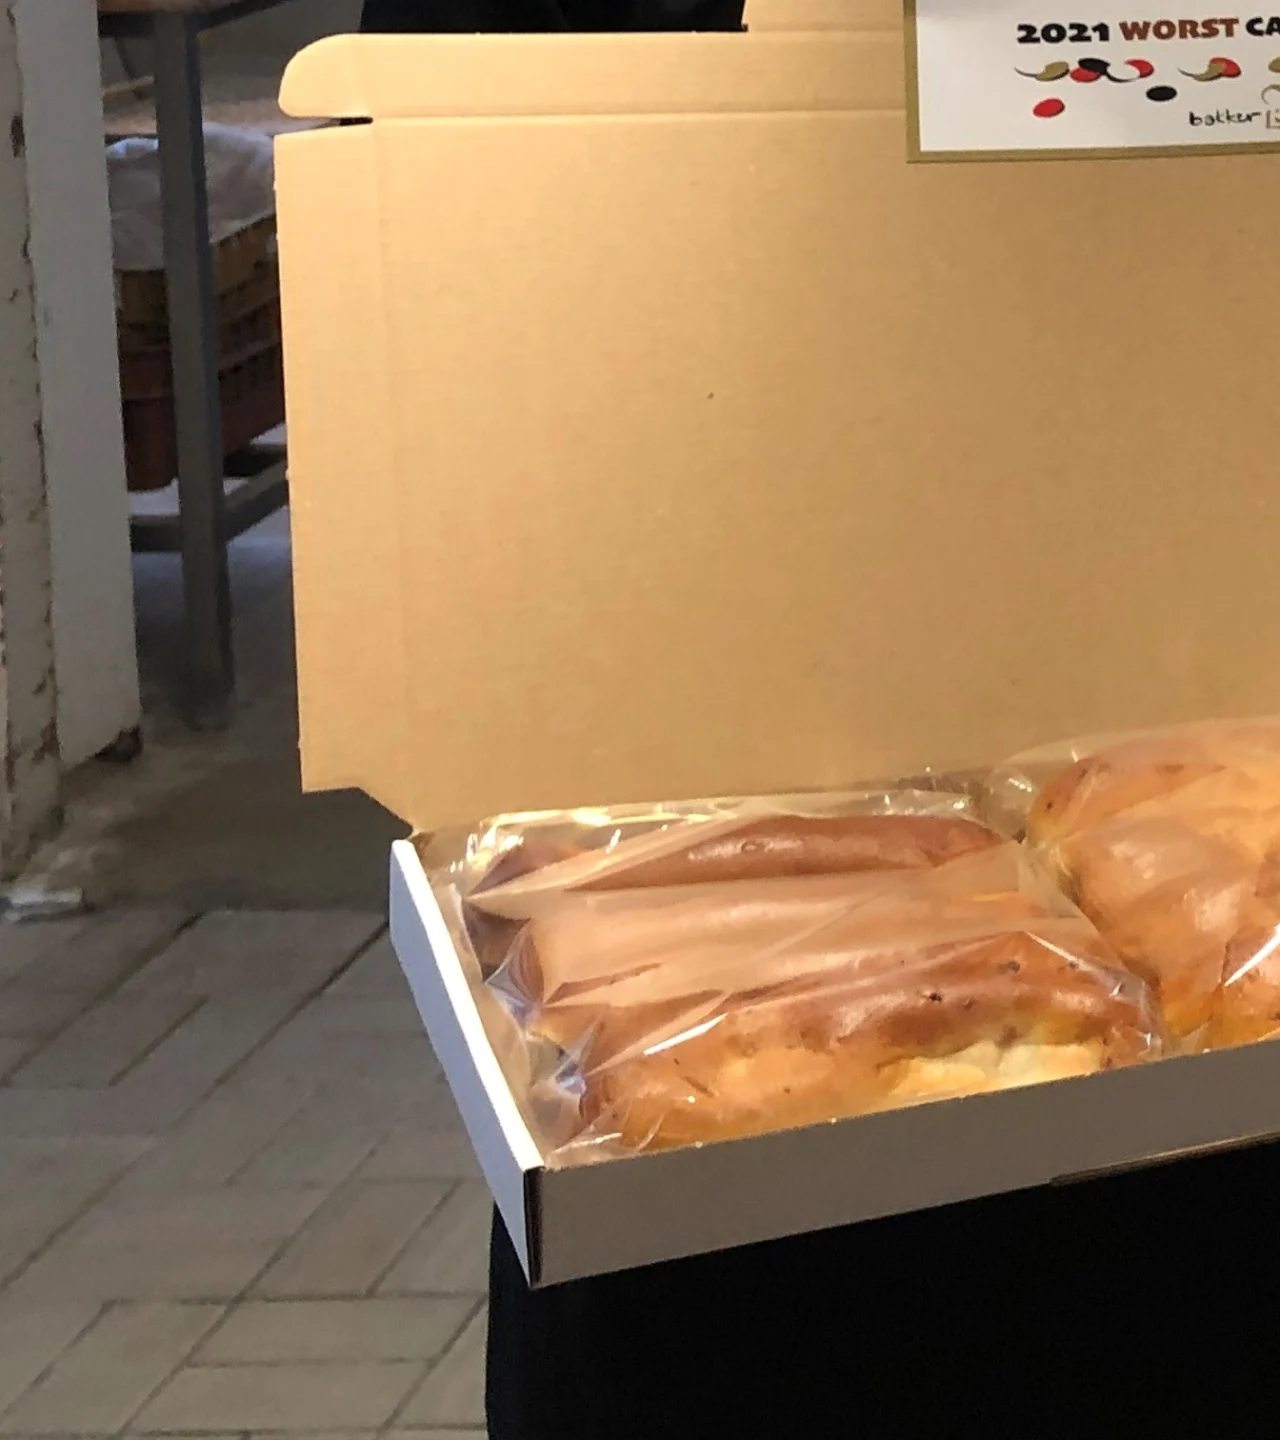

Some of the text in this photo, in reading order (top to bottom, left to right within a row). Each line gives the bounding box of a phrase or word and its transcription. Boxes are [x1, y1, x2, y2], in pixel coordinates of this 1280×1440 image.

[1017, 23, 1110, 44] 2021
[1120, 18, 1240, 40] WORST
[1189, 109, 1261, 126] bakker
